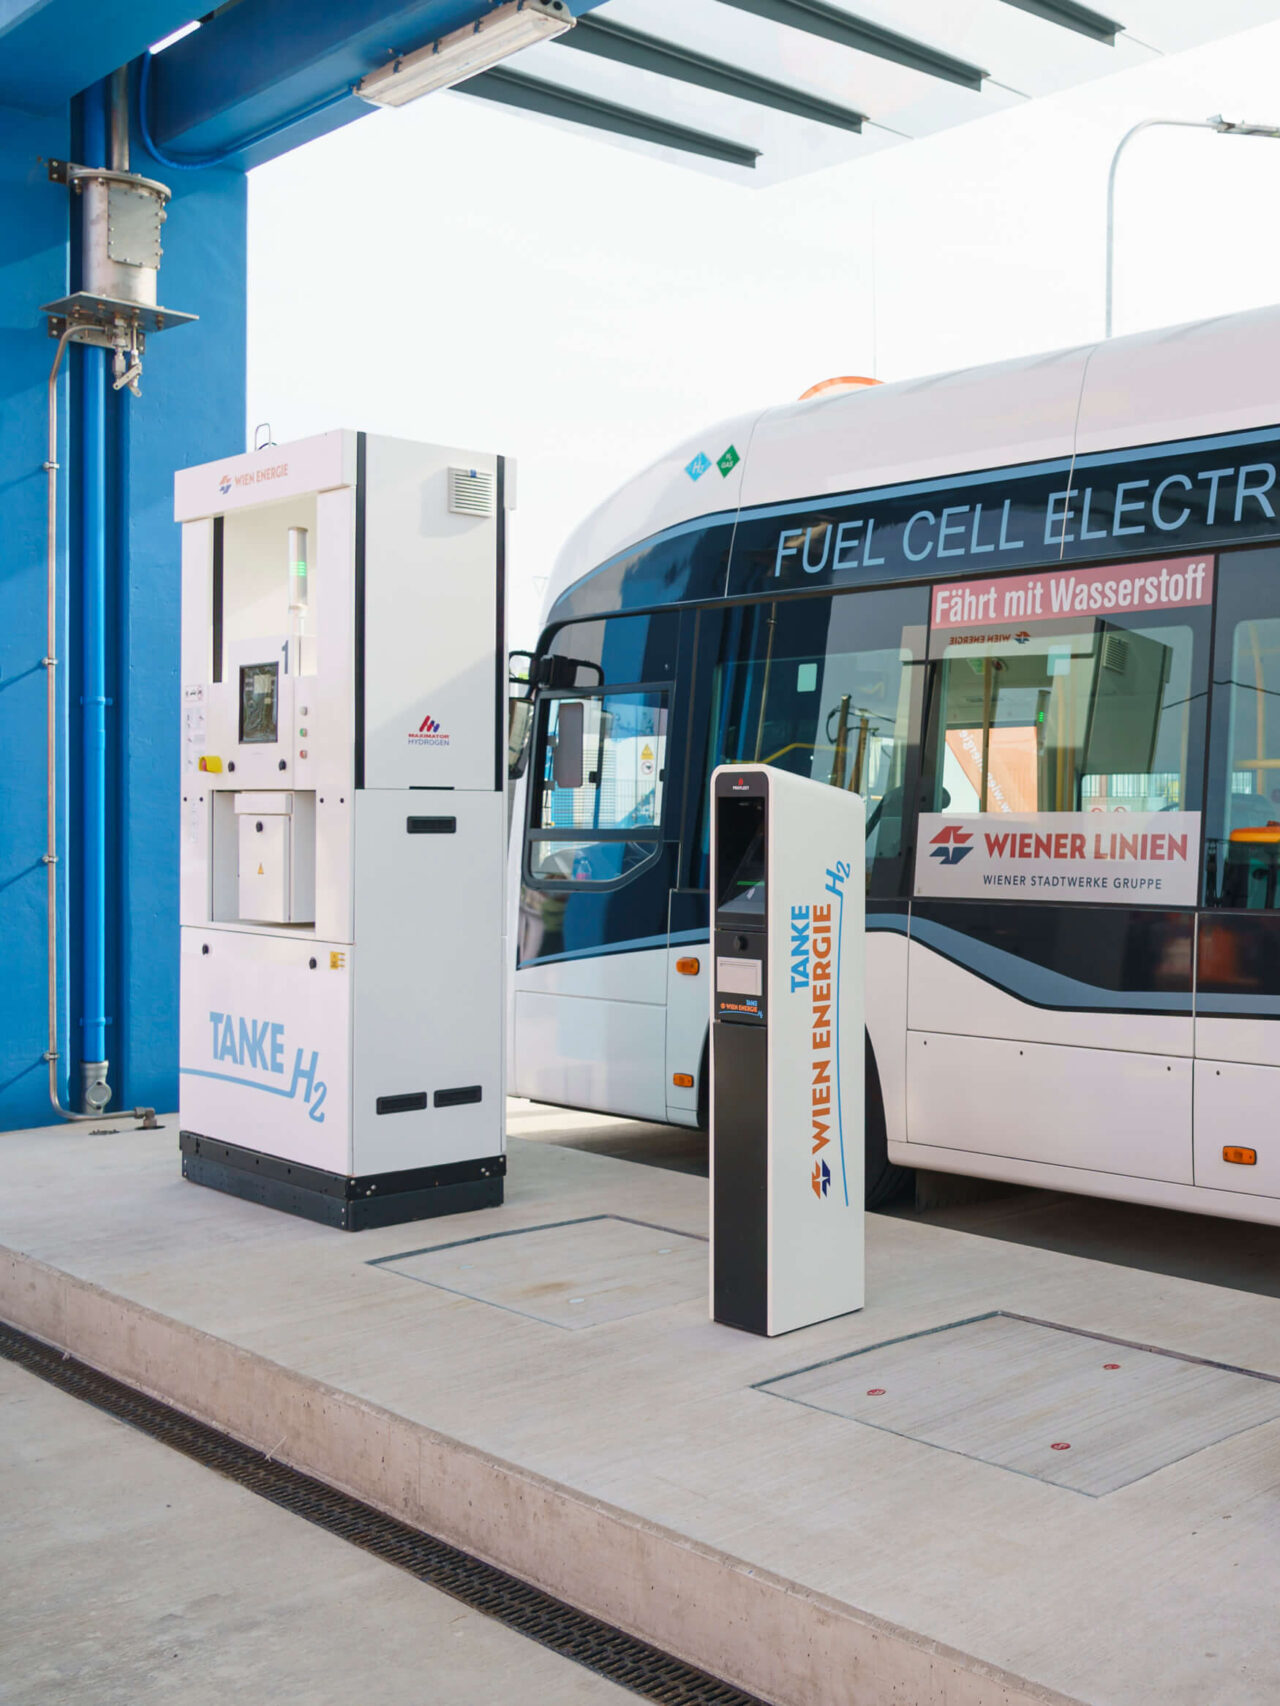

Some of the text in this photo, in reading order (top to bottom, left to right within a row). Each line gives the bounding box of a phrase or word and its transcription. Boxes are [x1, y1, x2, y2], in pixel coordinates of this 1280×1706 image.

[234, 462, 289, 487] WIEN ENERGIE
[774, 518, 887, 578] FUEL
[902, 499, 1025, 562] CELL
[935, 562, 1206, 624] Fährt mit Wasserstoff
[281, 639, 289, 675] 1
[984, 832, 1188, 862] WIENER LINIEN
[825, 860, 851, 899] H2
[983, 874, 1162, 890] WIENER STADTWERKE GRUPPE
[791, 904, 810, 994] TANKE
[812, 903, 831, 1155] WIEN ENERGIE
[209, 1011, 328, 1123] TANKE H2
